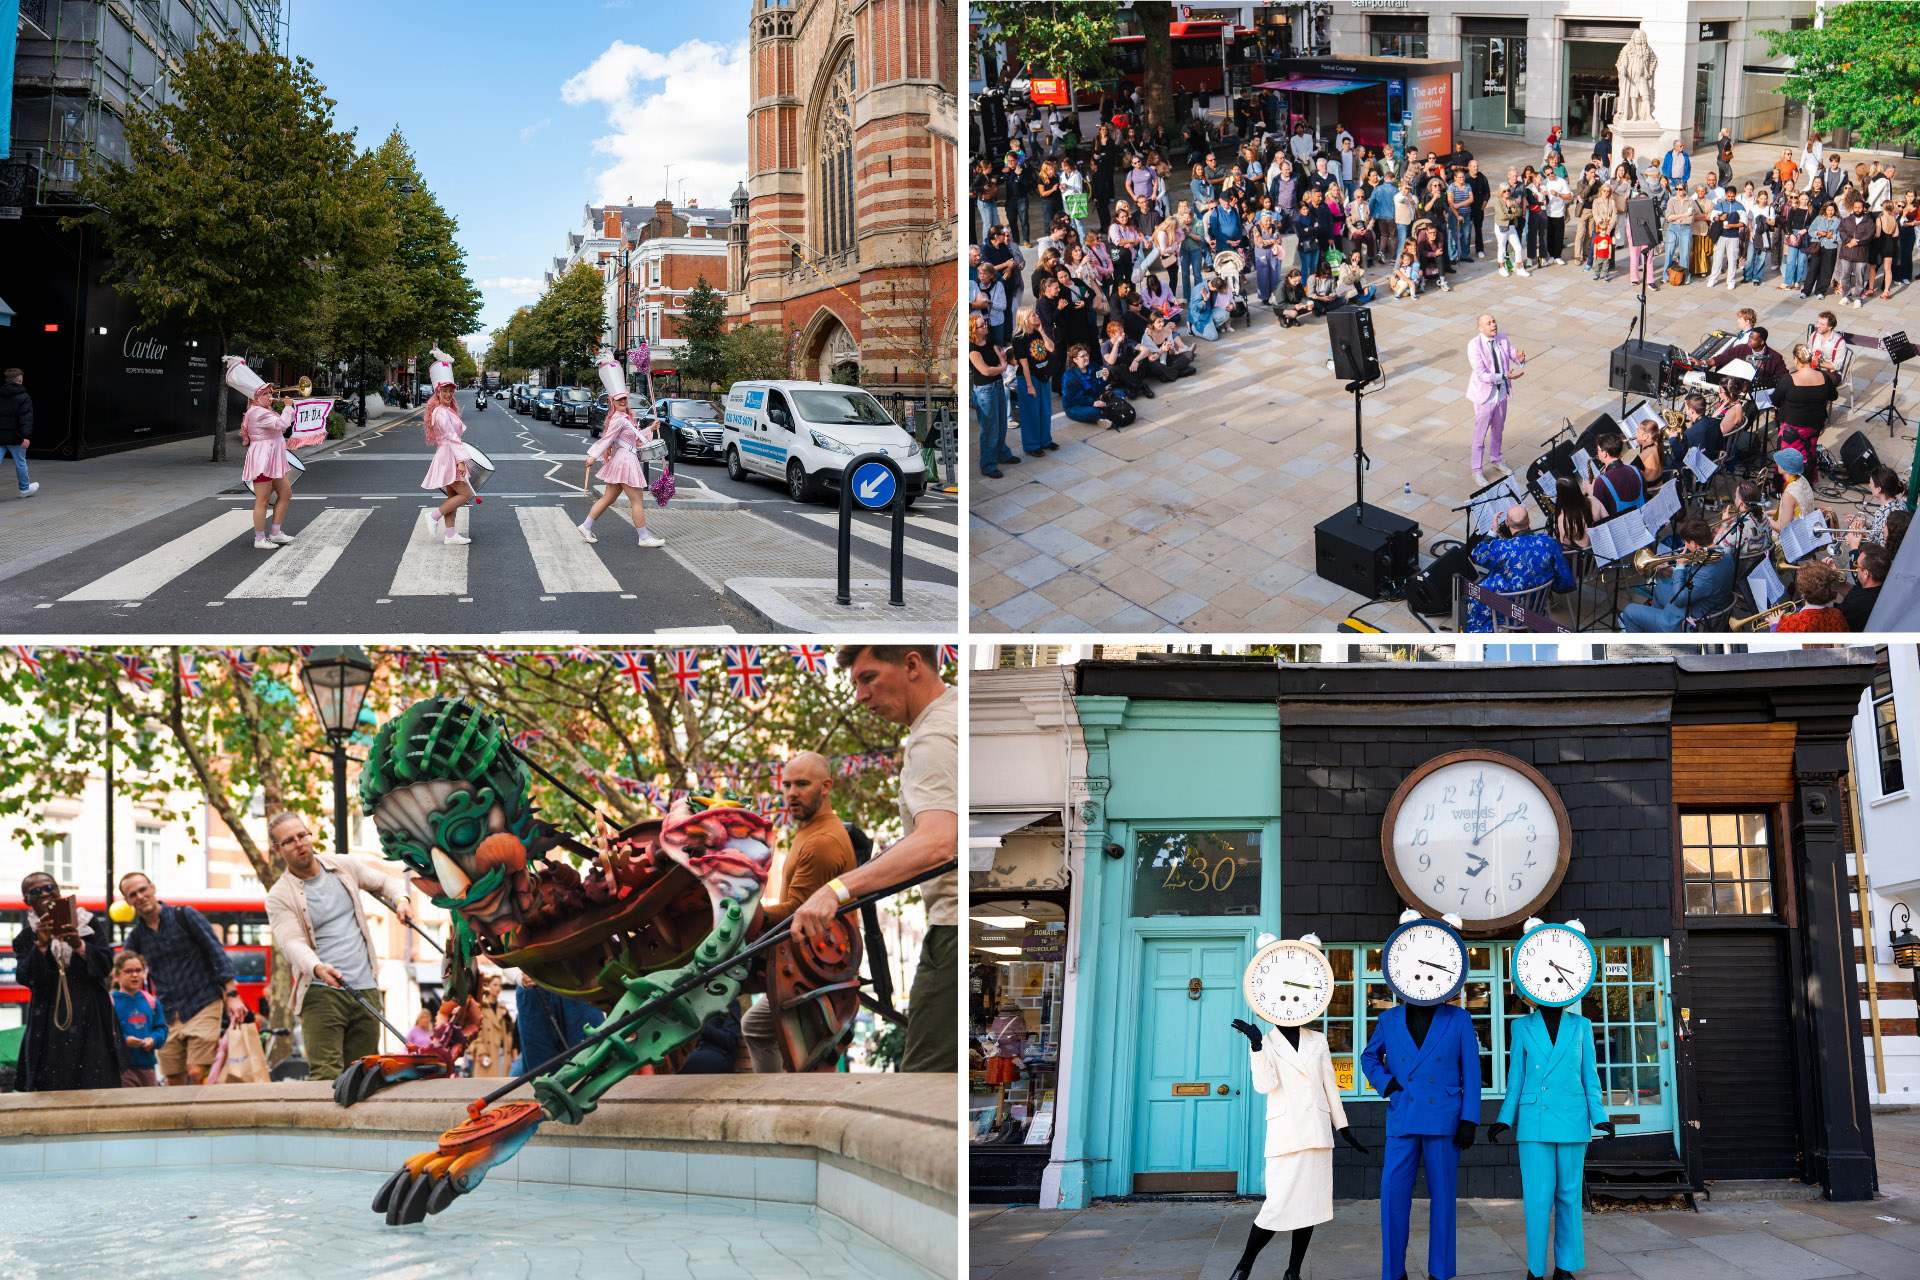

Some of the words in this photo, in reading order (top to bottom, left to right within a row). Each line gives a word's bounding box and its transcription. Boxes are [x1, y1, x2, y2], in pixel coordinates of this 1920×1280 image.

[1351, 0, 1408, 8] self-portrait
[1412, 87, 1426, 98] The
[1428, 86, 1438, 96] art
[1438, 83, 1446, 94] of
[1416, 97, 1442, 110] arrival
[123, 325, 168, 360] Cartier
[1443, 786, 1456, 803] 12
[1497, 785, 1504, 801] 1
[1424, 804, 1435, 821] 11
[1452, 806, 1496, 820] words
[1518, 803, 1528, 820] 2
[1464, 820, 1486, 832] end
[1411, 829, 1428, 846] 10
[1526, 825, 1537, 842] 3
[1418, 854, 1431, 872] 9
[1523, 850, 1537, 868] 4
[1433, 876, 1445, 893] 8
[1509, 872, 1522, 891] 5
[1458, 888, 1469, 905] 7
[1485, 886, 1497, 905] 6
[1409, 934, 1416, 942] 11
[1425, 930, 1432, 939] 12
[1552, 934, 1560, 942] 12
[1442, 936, 1445, 945] 1
[1397, 943, 1407, 951] 10
[1288, 950, 1294, 959] 12
[1450, 948, 1455, 956] 2
[1527, 948, 1535, 956] 10
[1578, 950, 1582, 958] 2
[1272, 956, 1278, 964] 11
[1394, 956, 1399, 964] 9
[1523, 960, 1528, 968] 9
[1260, 965, 1270, 974] 10
[1453, 961, 1457, 969] 3
[1314, 967, 1319, 976] 2
[1395, 970, 1400, 978] 8
[1406, 980, 1410, 988] 7
[1436, 984, 1440, 992] 5
[1537, 984, 1541, 992] 7
[1420, 987, 1425, 995] 6
[1260, 992, 1266, 1001] 8
[1272, 1002, 1276, 1011] 7
[1287, 1008, 1292, 1016] 6
[1340, 1074, 1353, 1083] en
